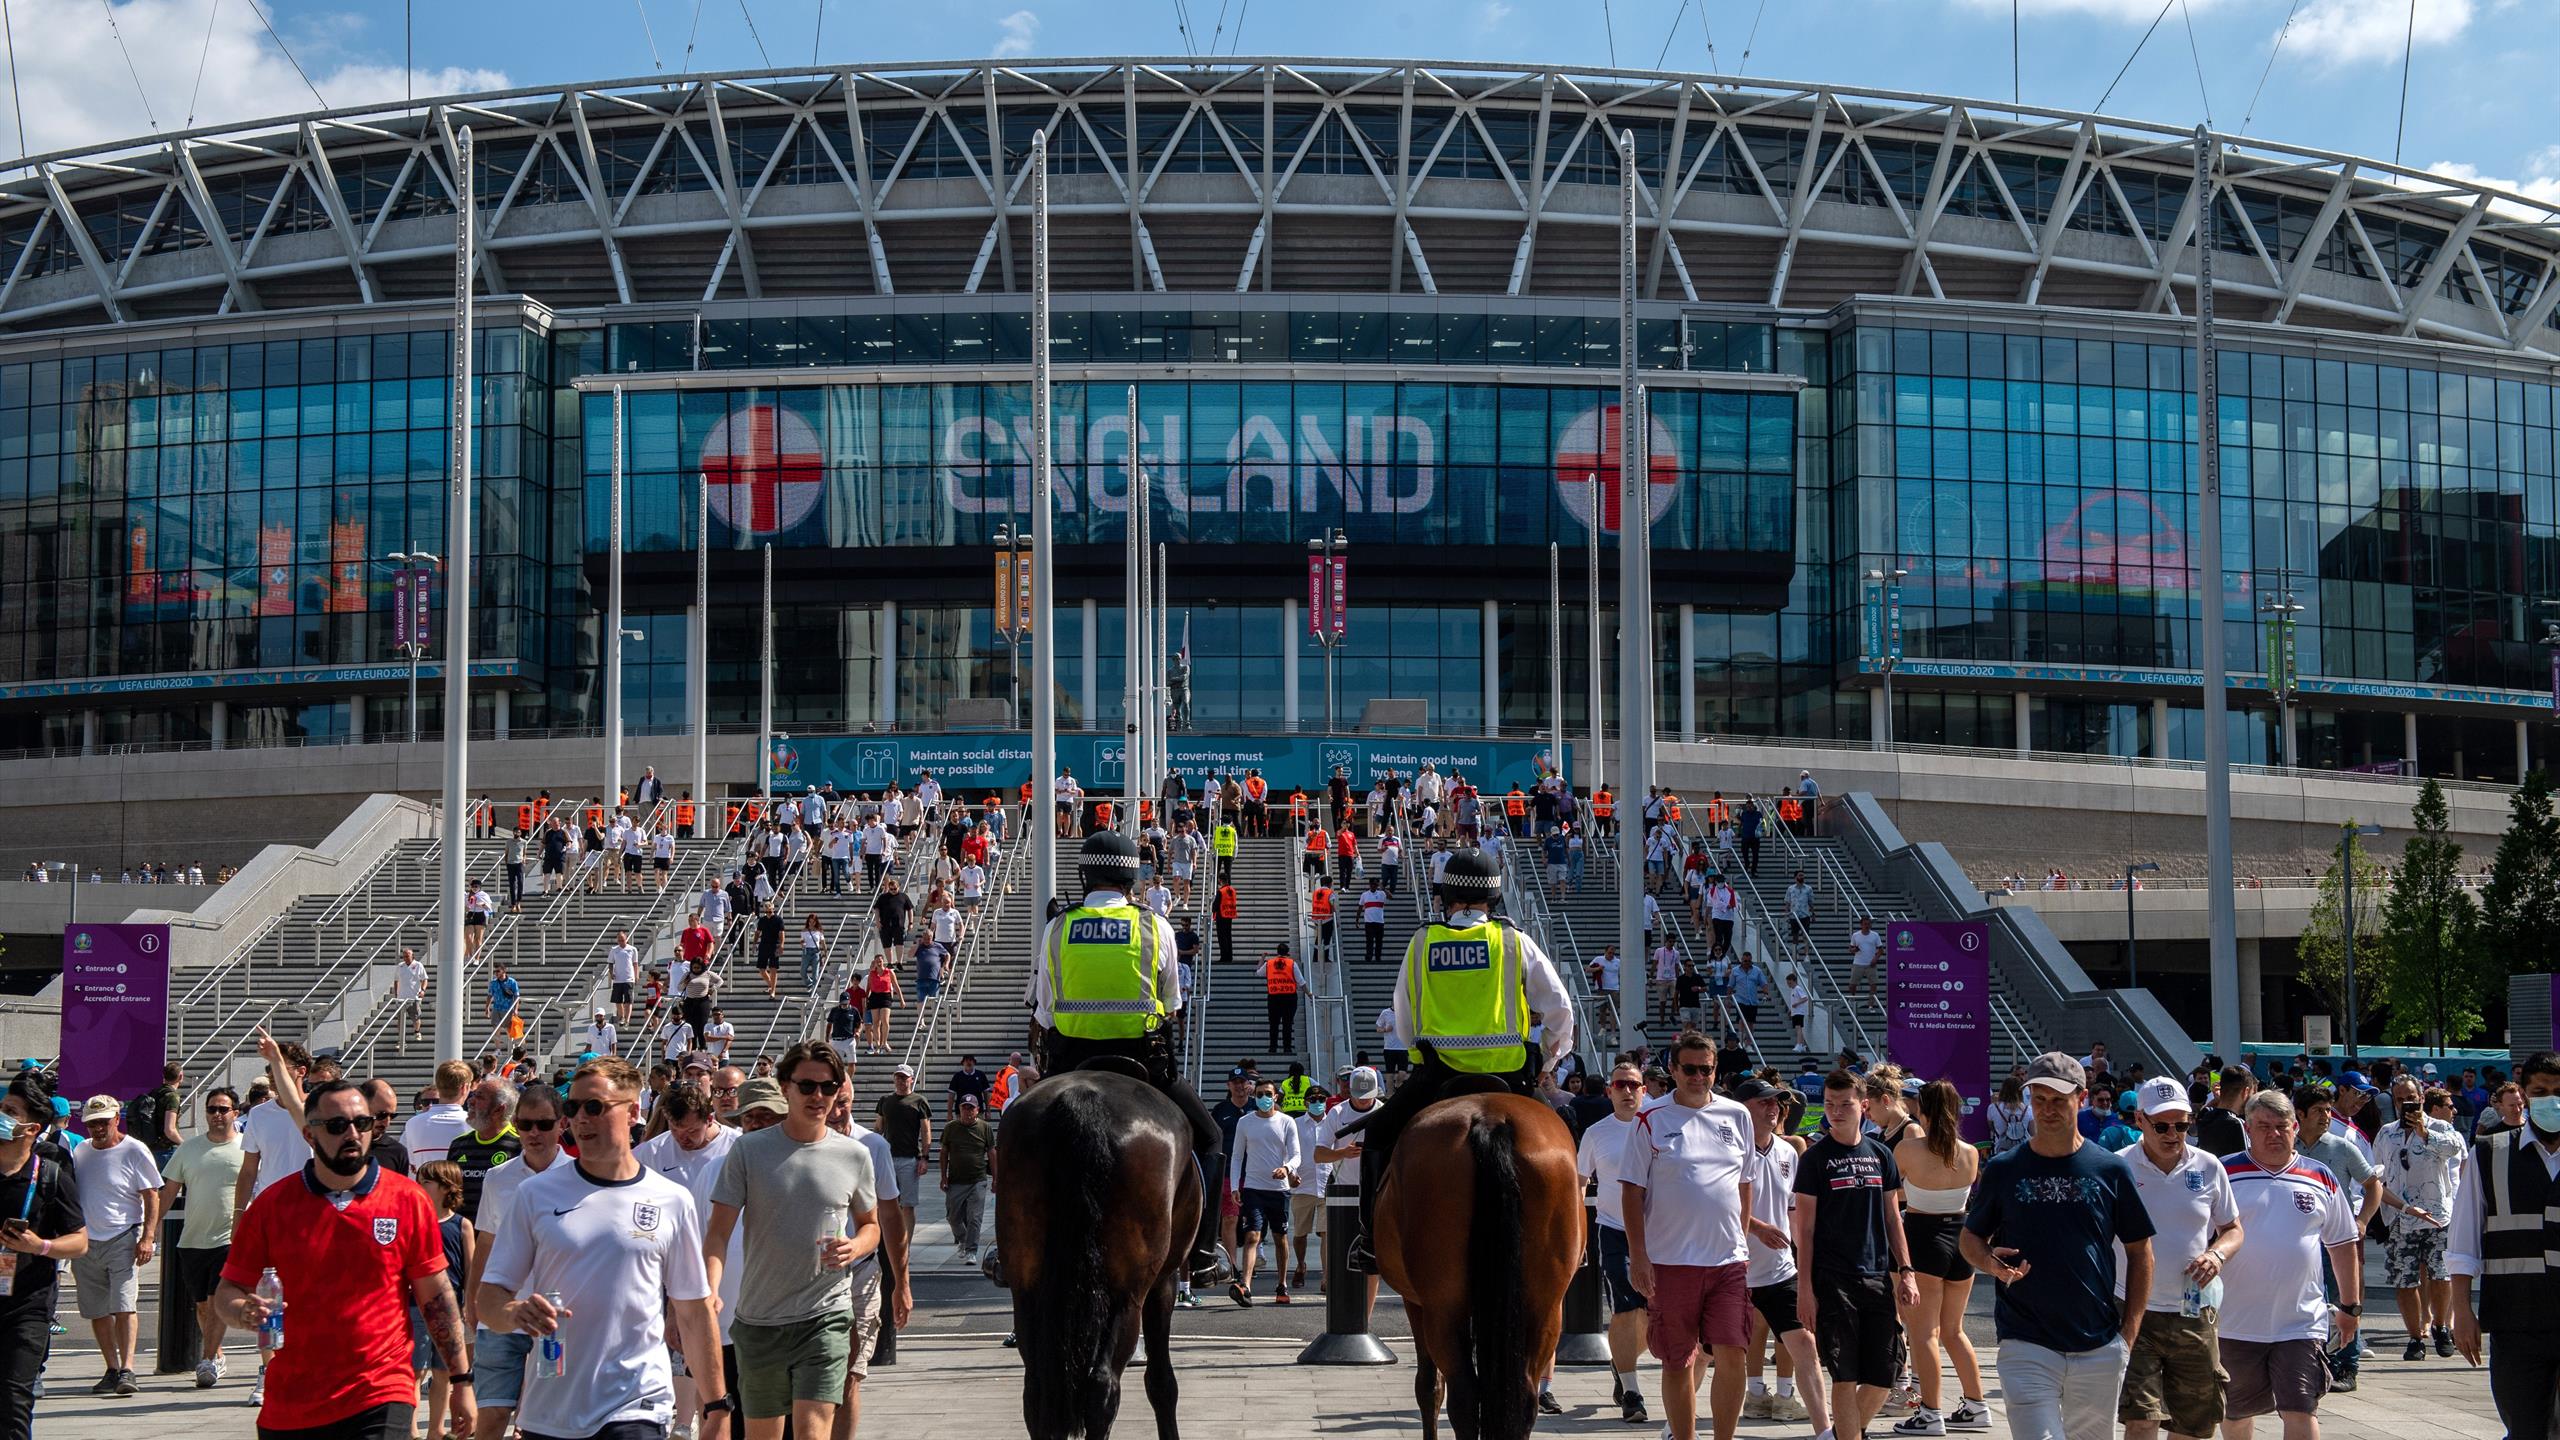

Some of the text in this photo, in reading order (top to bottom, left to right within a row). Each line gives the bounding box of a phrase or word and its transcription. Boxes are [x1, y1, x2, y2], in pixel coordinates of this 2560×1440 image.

[944, 414, 1435, 513] ENGLAND
[336, 668, 410, 680] UEFA EURO 202
[1912, 664, 1994, 676] UEFA EURO 2020
[119, 678, 193, 690] UEFA EURO 2020
[2140, 673, 2204, 684] UEFA EURO 20
[2348, 684, 2416, 697] UEFA EURO 2020
[2532, 698, 2553, 707] UEFA
[910, 748, 1032, 760] Maintain social distan
[1176, 750, 1231, 763] coverings
[1234, 752, 1264, 761] must
[1370, 753, 1477, 766] Maintain good hand
[910, 764, 994, 776] where possible
[1197, 766, 1209, 776] at
[1213, 766, 1227, 776] all
[1370, 767, 1413, 779] hygene
[1072, 922, 1127, 939] POLICE
[1431, 946, 1486, 966] POLICE
[1826, 1156, 1880, 1170] Abercrombie
[1851, 1165, 1874, 1174] Fitch
